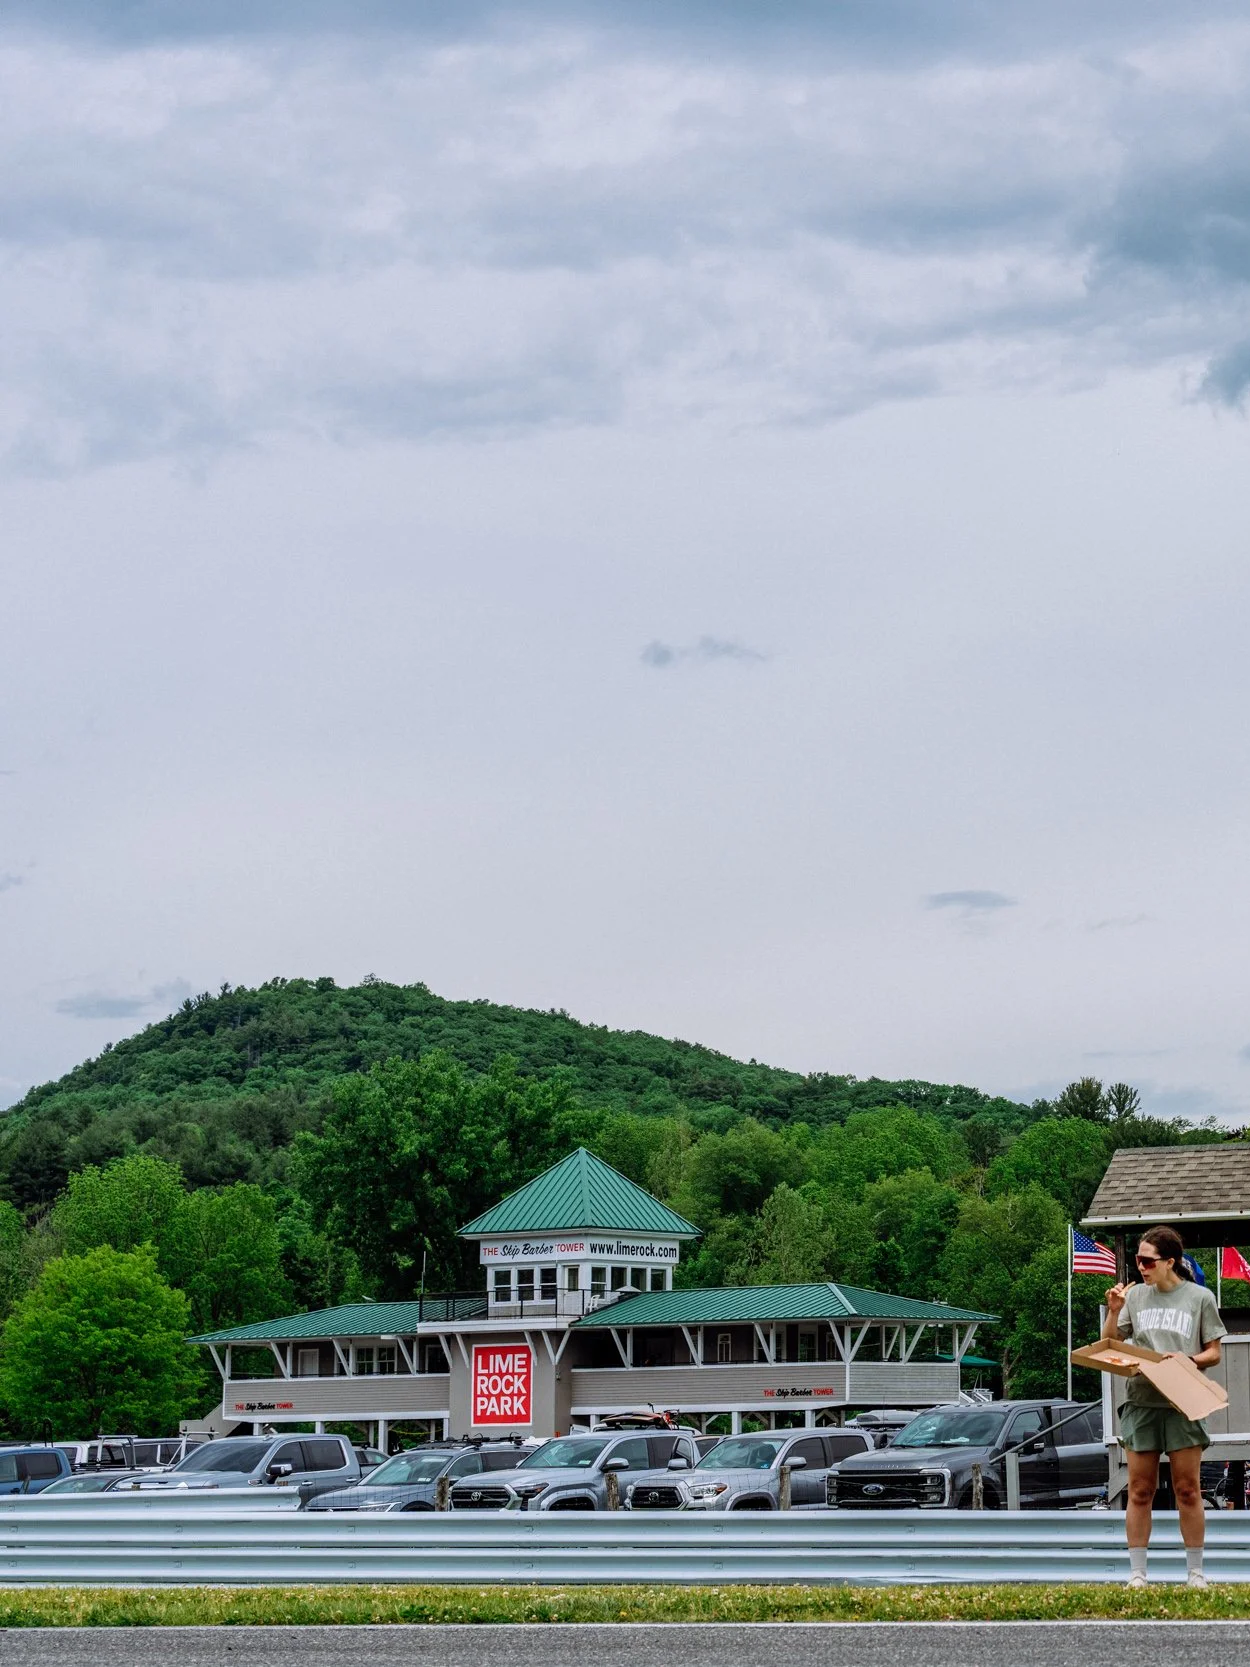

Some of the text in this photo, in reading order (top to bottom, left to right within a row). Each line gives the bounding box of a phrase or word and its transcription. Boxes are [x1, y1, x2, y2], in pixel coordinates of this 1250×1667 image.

[483, 1243, 585, 1259] THE Skip Barber TOWER
[589, 1241, 677, 1258] www.limerock.com
[1160, 1308, 1192, 1339] ISLAND
[477, 1353, 528, 1374] LIME
[476, 1374, 527, 1395] ROCK
[476, 1395, 527, 1416] PARK
